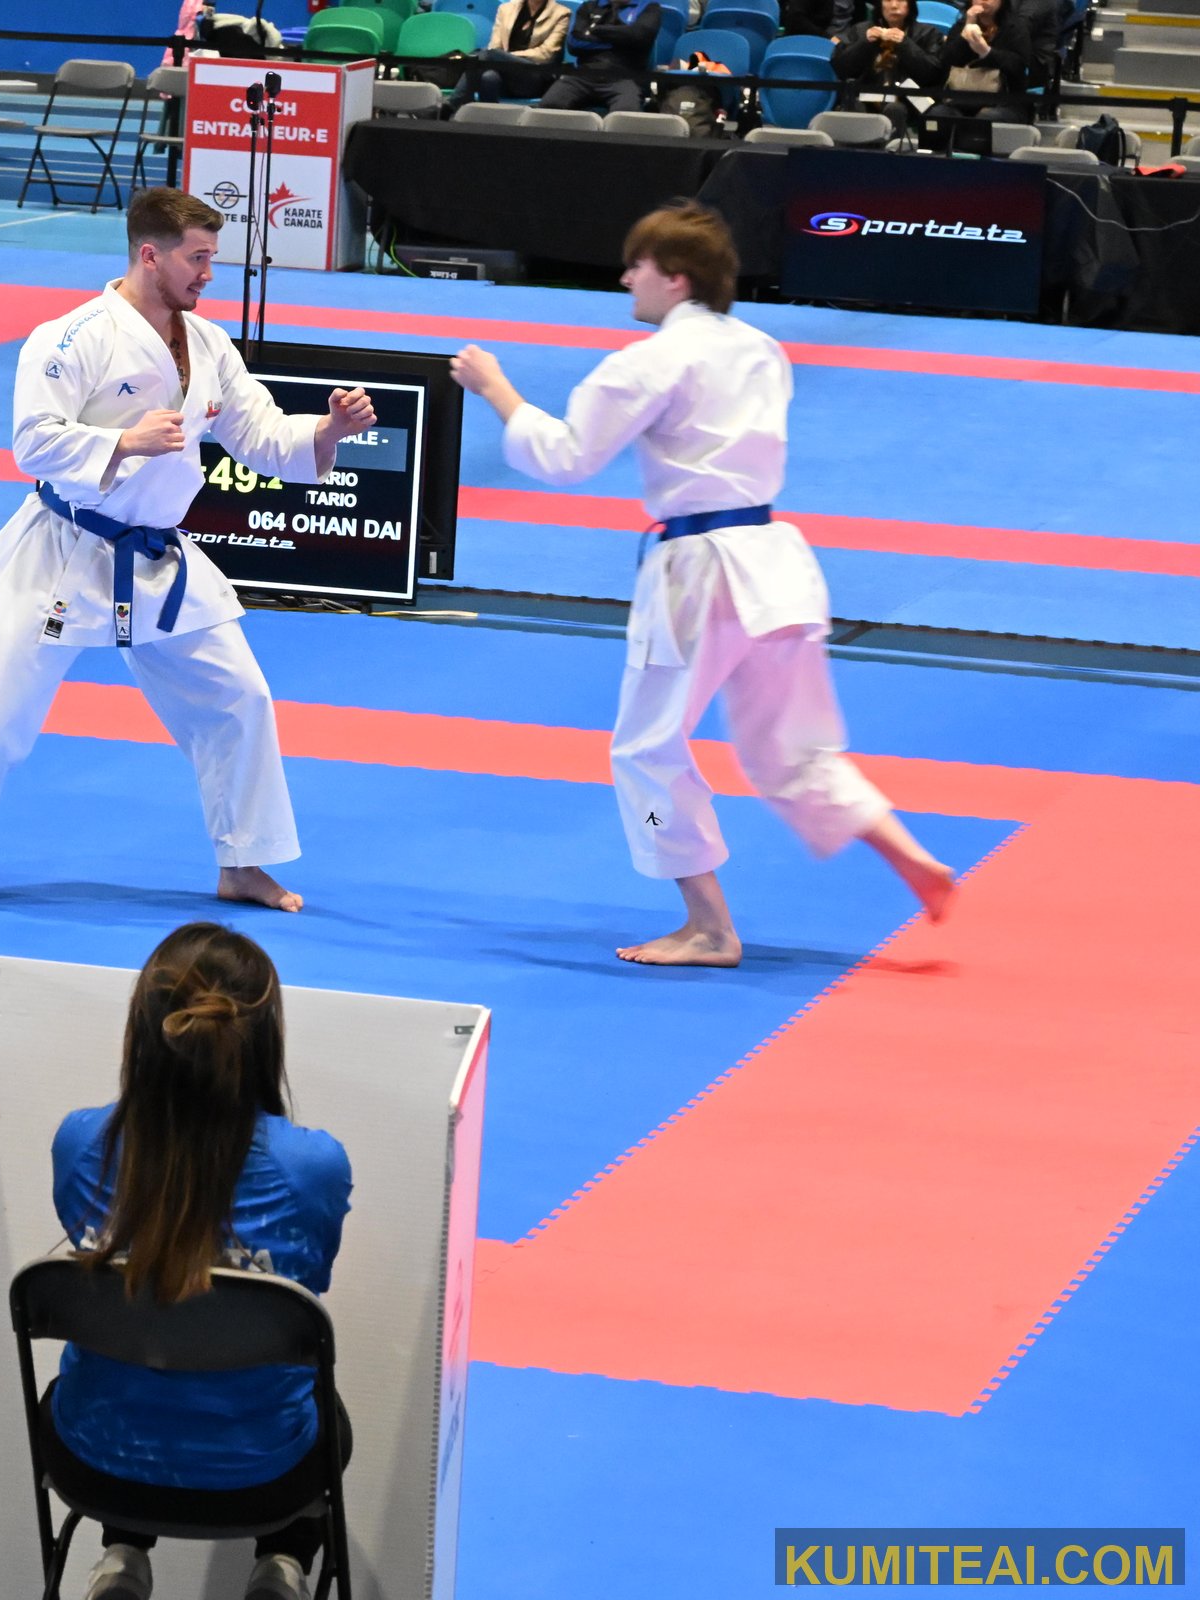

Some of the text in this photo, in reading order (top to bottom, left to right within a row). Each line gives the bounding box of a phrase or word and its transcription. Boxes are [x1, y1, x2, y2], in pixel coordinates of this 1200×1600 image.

[284, 208, 323, 219] KARATE
[283, 218, 323, 229] CANADA
[248, 510, 402, 541] 064 OHAN DAI
[187, 532, 297, 550] portdata
